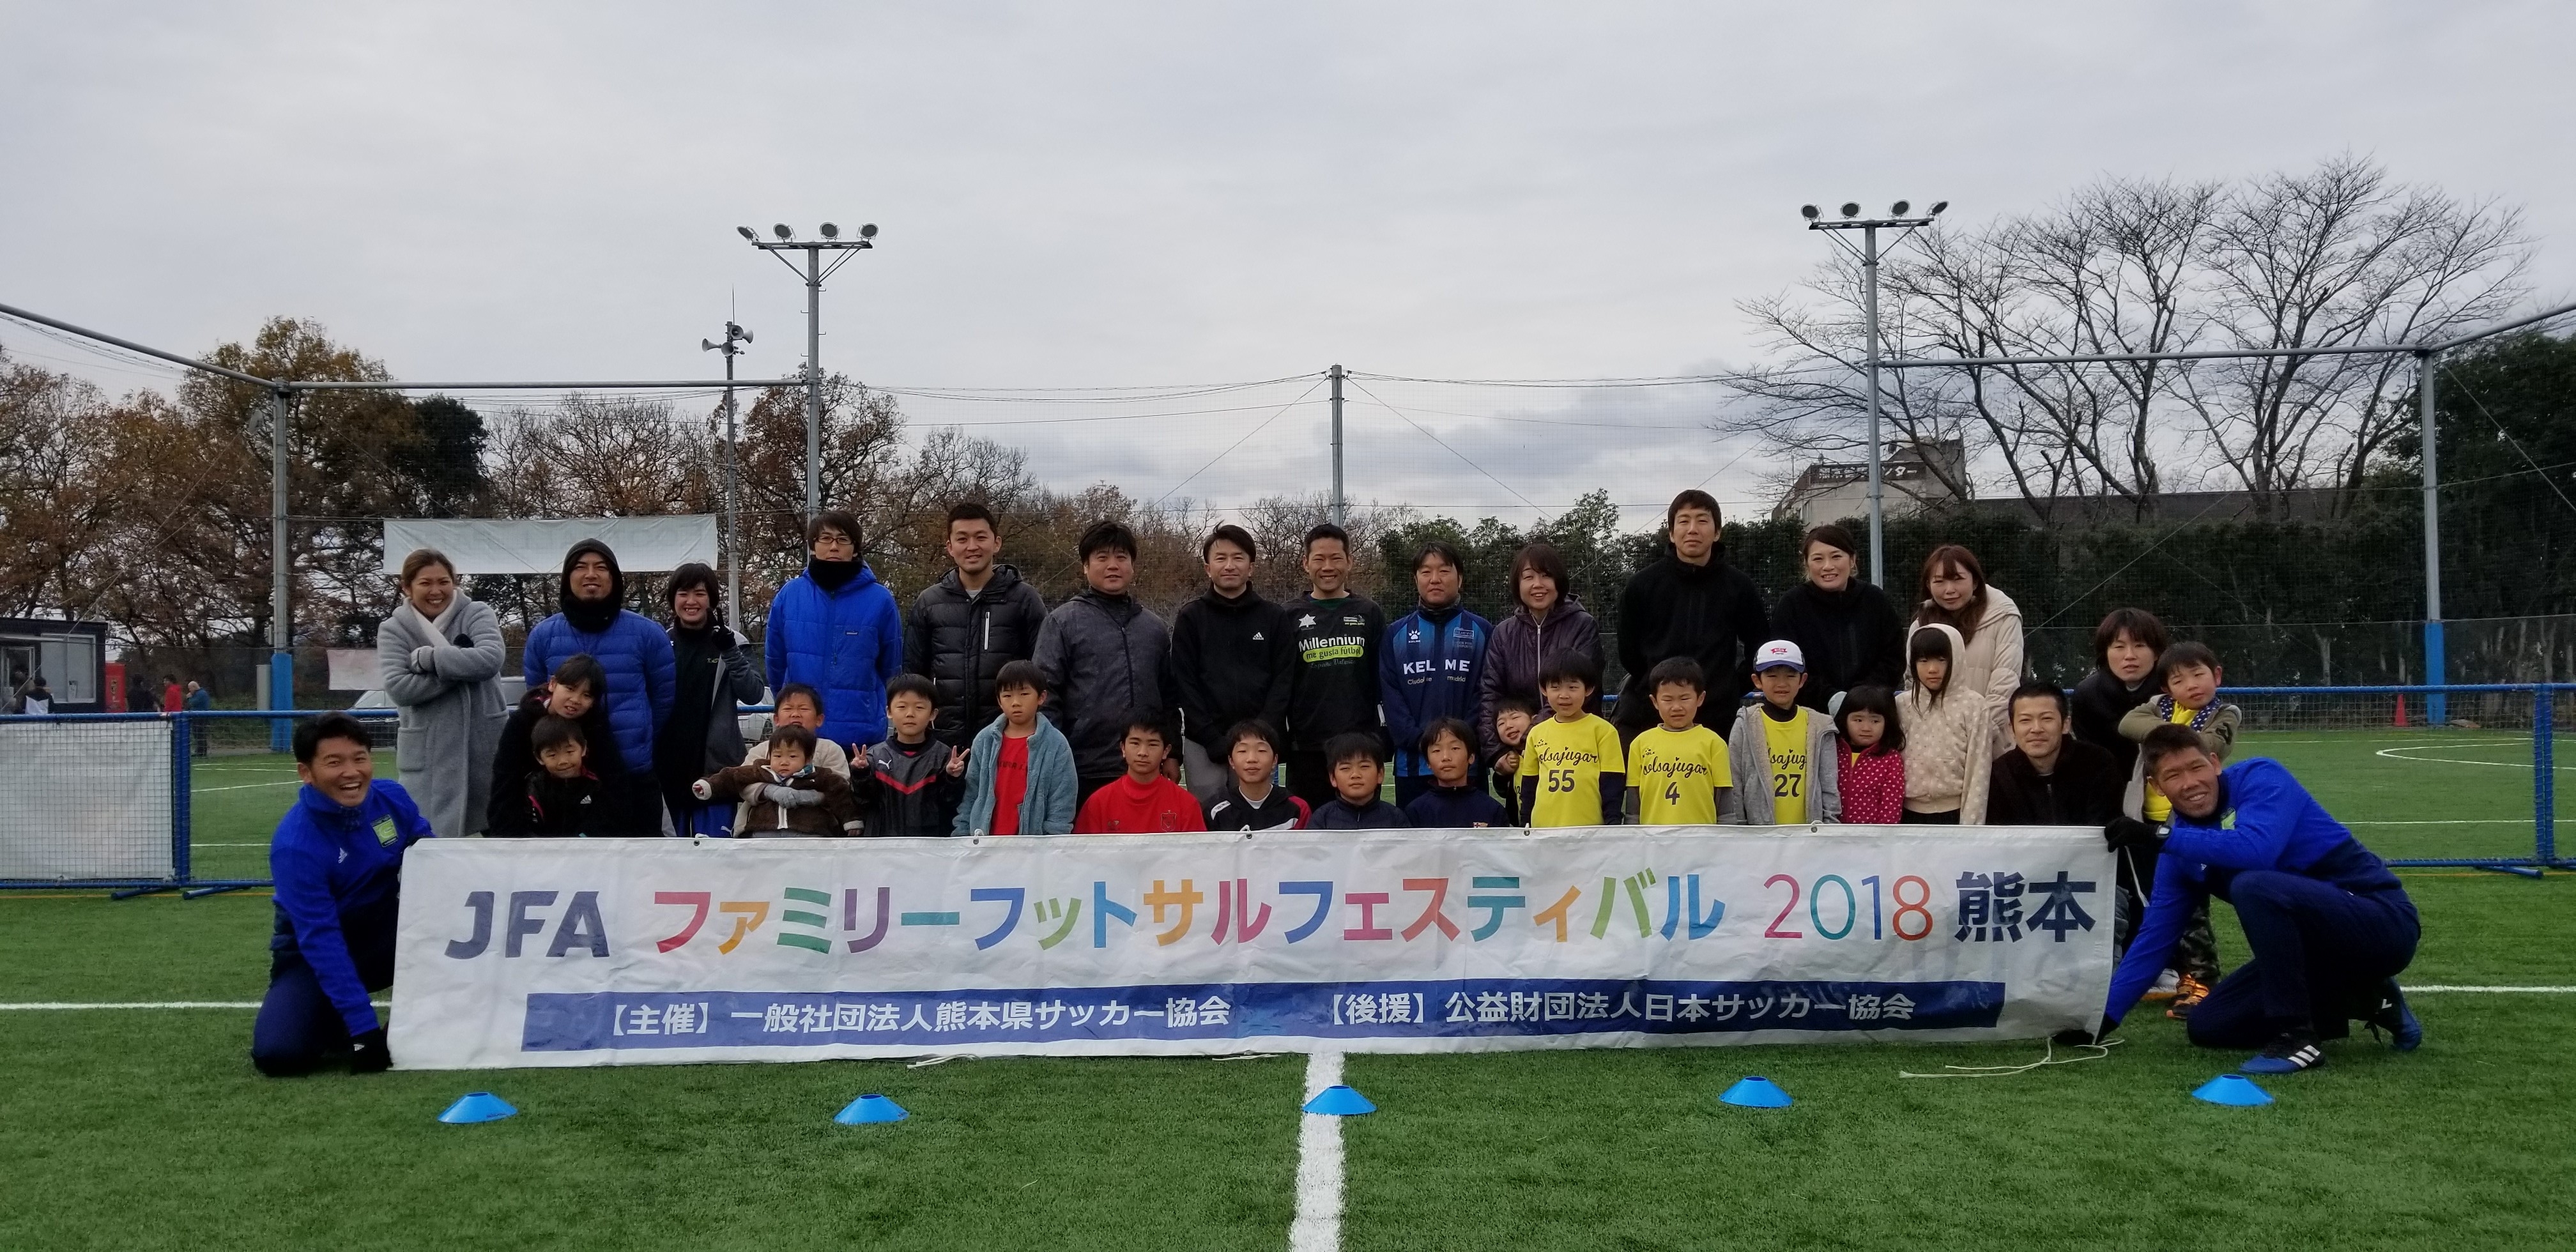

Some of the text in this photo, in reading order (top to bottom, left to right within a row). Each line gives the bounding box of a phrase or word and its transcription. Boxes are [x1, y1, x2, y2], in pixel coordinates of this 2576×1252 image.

[1298, 634, 1365, 652] Millennium
[1319, 648, 1338, 659] gusta
[1340, 646, 1361, 655] fútbol
[1548, 770, 1575, 792] 55
[1774, 774, 1802, 797] 27
[1665, 782, 1680, 805] 4
[445, 867, 2097, 959] JFA ファミリーフットサルフェスティバル 2018 熊本
